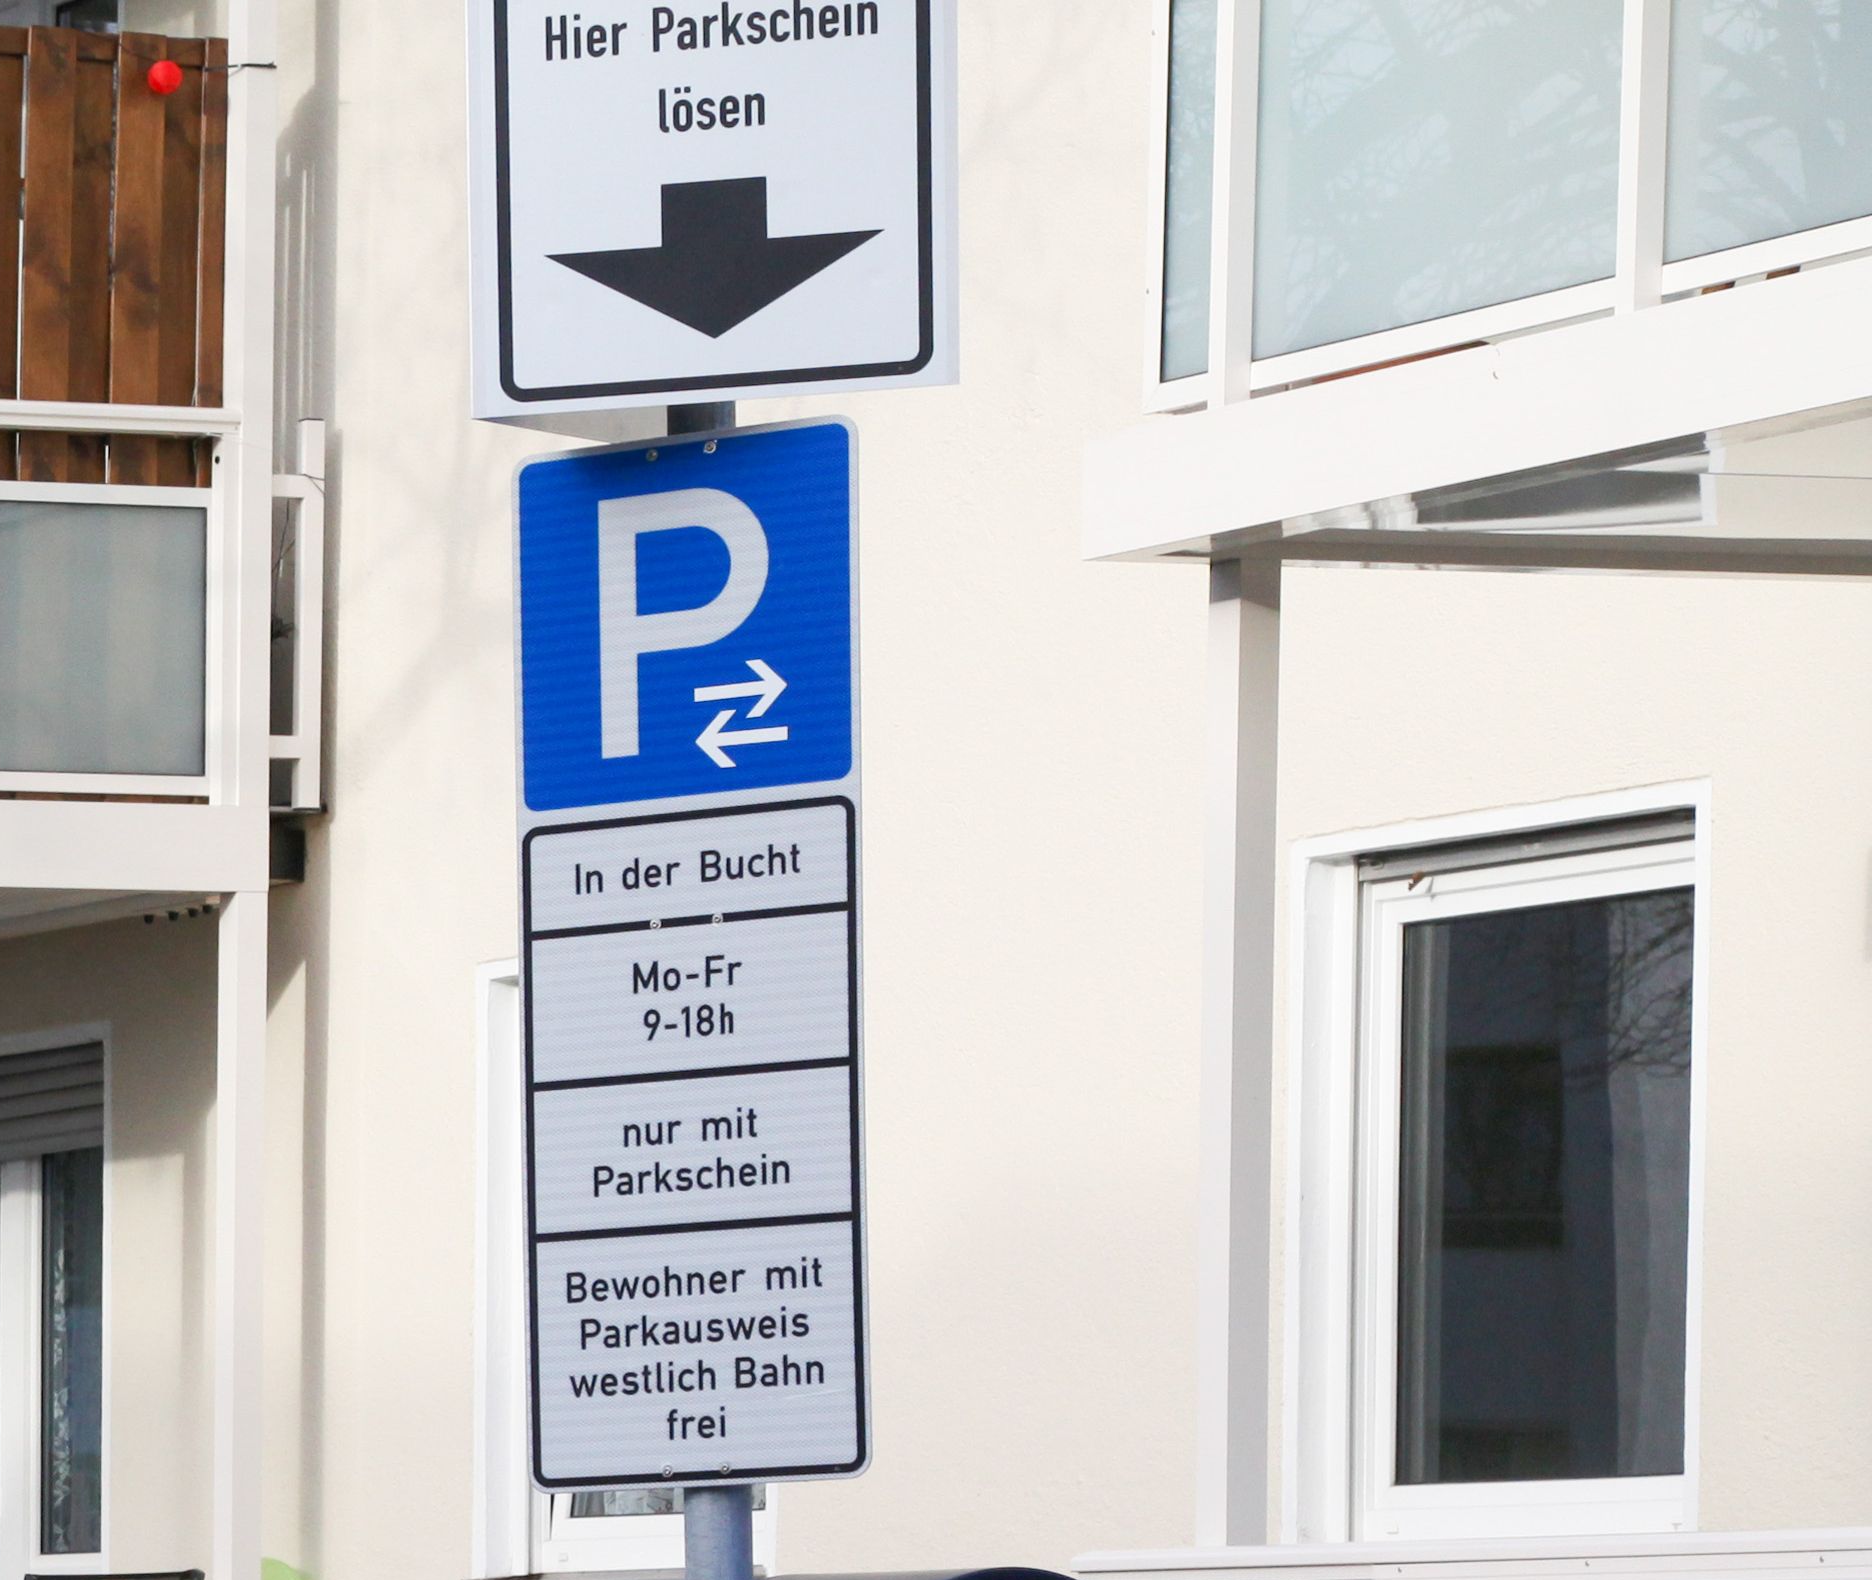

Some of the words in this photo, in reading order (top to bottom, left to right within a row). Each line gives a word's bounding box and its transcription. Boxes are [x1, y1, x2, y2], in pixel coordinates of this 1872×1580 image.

[544, 13, 628, 62] Hier
[651, 0, 879, 54] Parkschein
[657, 85, 767, 134] lösen
[597, 487, 770, 760] P
[574, 862, 605, 896] In
[620, 857, 681, 891] der
[699, 842, 802, 884] Bucht
[631, 953, 744, 996] Mo-Fr
[642, 1002, 735, 1042] 9-18h
[622, 1119, 683, 1149] nur
[700, 1105, 759, 1143] mit
[592, 1152, 791, 1199] Parkschein
[565, 1264, 747, 1305] Bewohner
[764, 1255, 824, 1292] mit
[579, 1304, 811, 1352] Parkausweis
[568, 1358, 718, 1399] westlich
[733, 1353, 826, 1390] Bahn
[665, 1404, 728, 1442] frei
